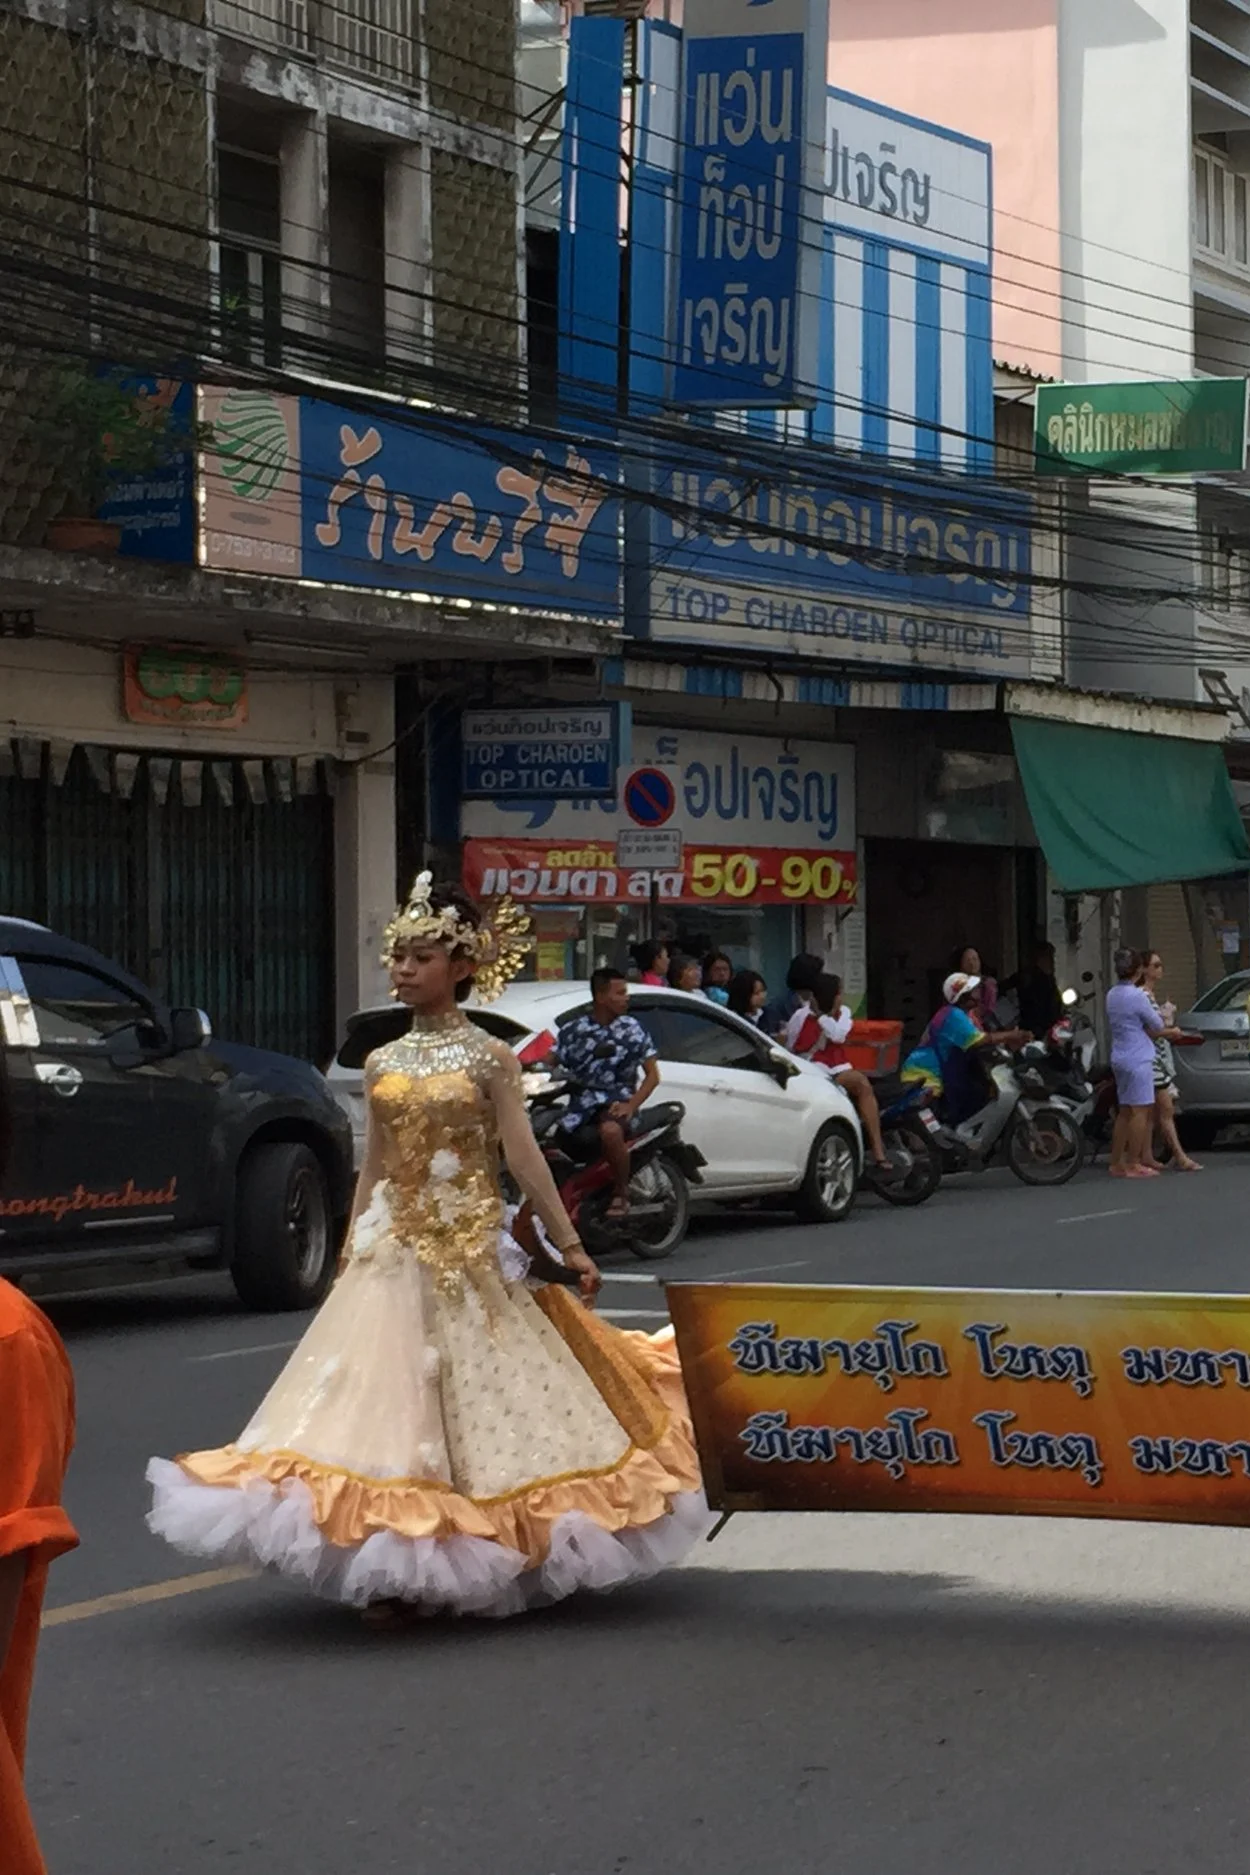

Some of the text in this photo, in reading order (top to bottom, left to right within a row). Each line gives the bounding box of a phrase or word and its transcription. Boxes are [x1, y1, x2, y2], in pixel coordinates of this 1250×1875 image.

[694, 48, 793, 147] แว่น
[697, 154, 786, 260] ท็อป
[683, 282, 791, 387] เจริญ
[666, 586, 730, 624] TOP
[900, 619, 1010, 660] OPTICAL
[466, 743, 608, 766] TOP CHAROEN
[479, 768, 592, 790] OPTICAL
[479, 861, 619, 898] แว่นตา
[627, 868, 685, 899] ลด
[963, 1321, 1093, 1398] โหตุ
[972, 1408, 1104, 1487] โหตุ
